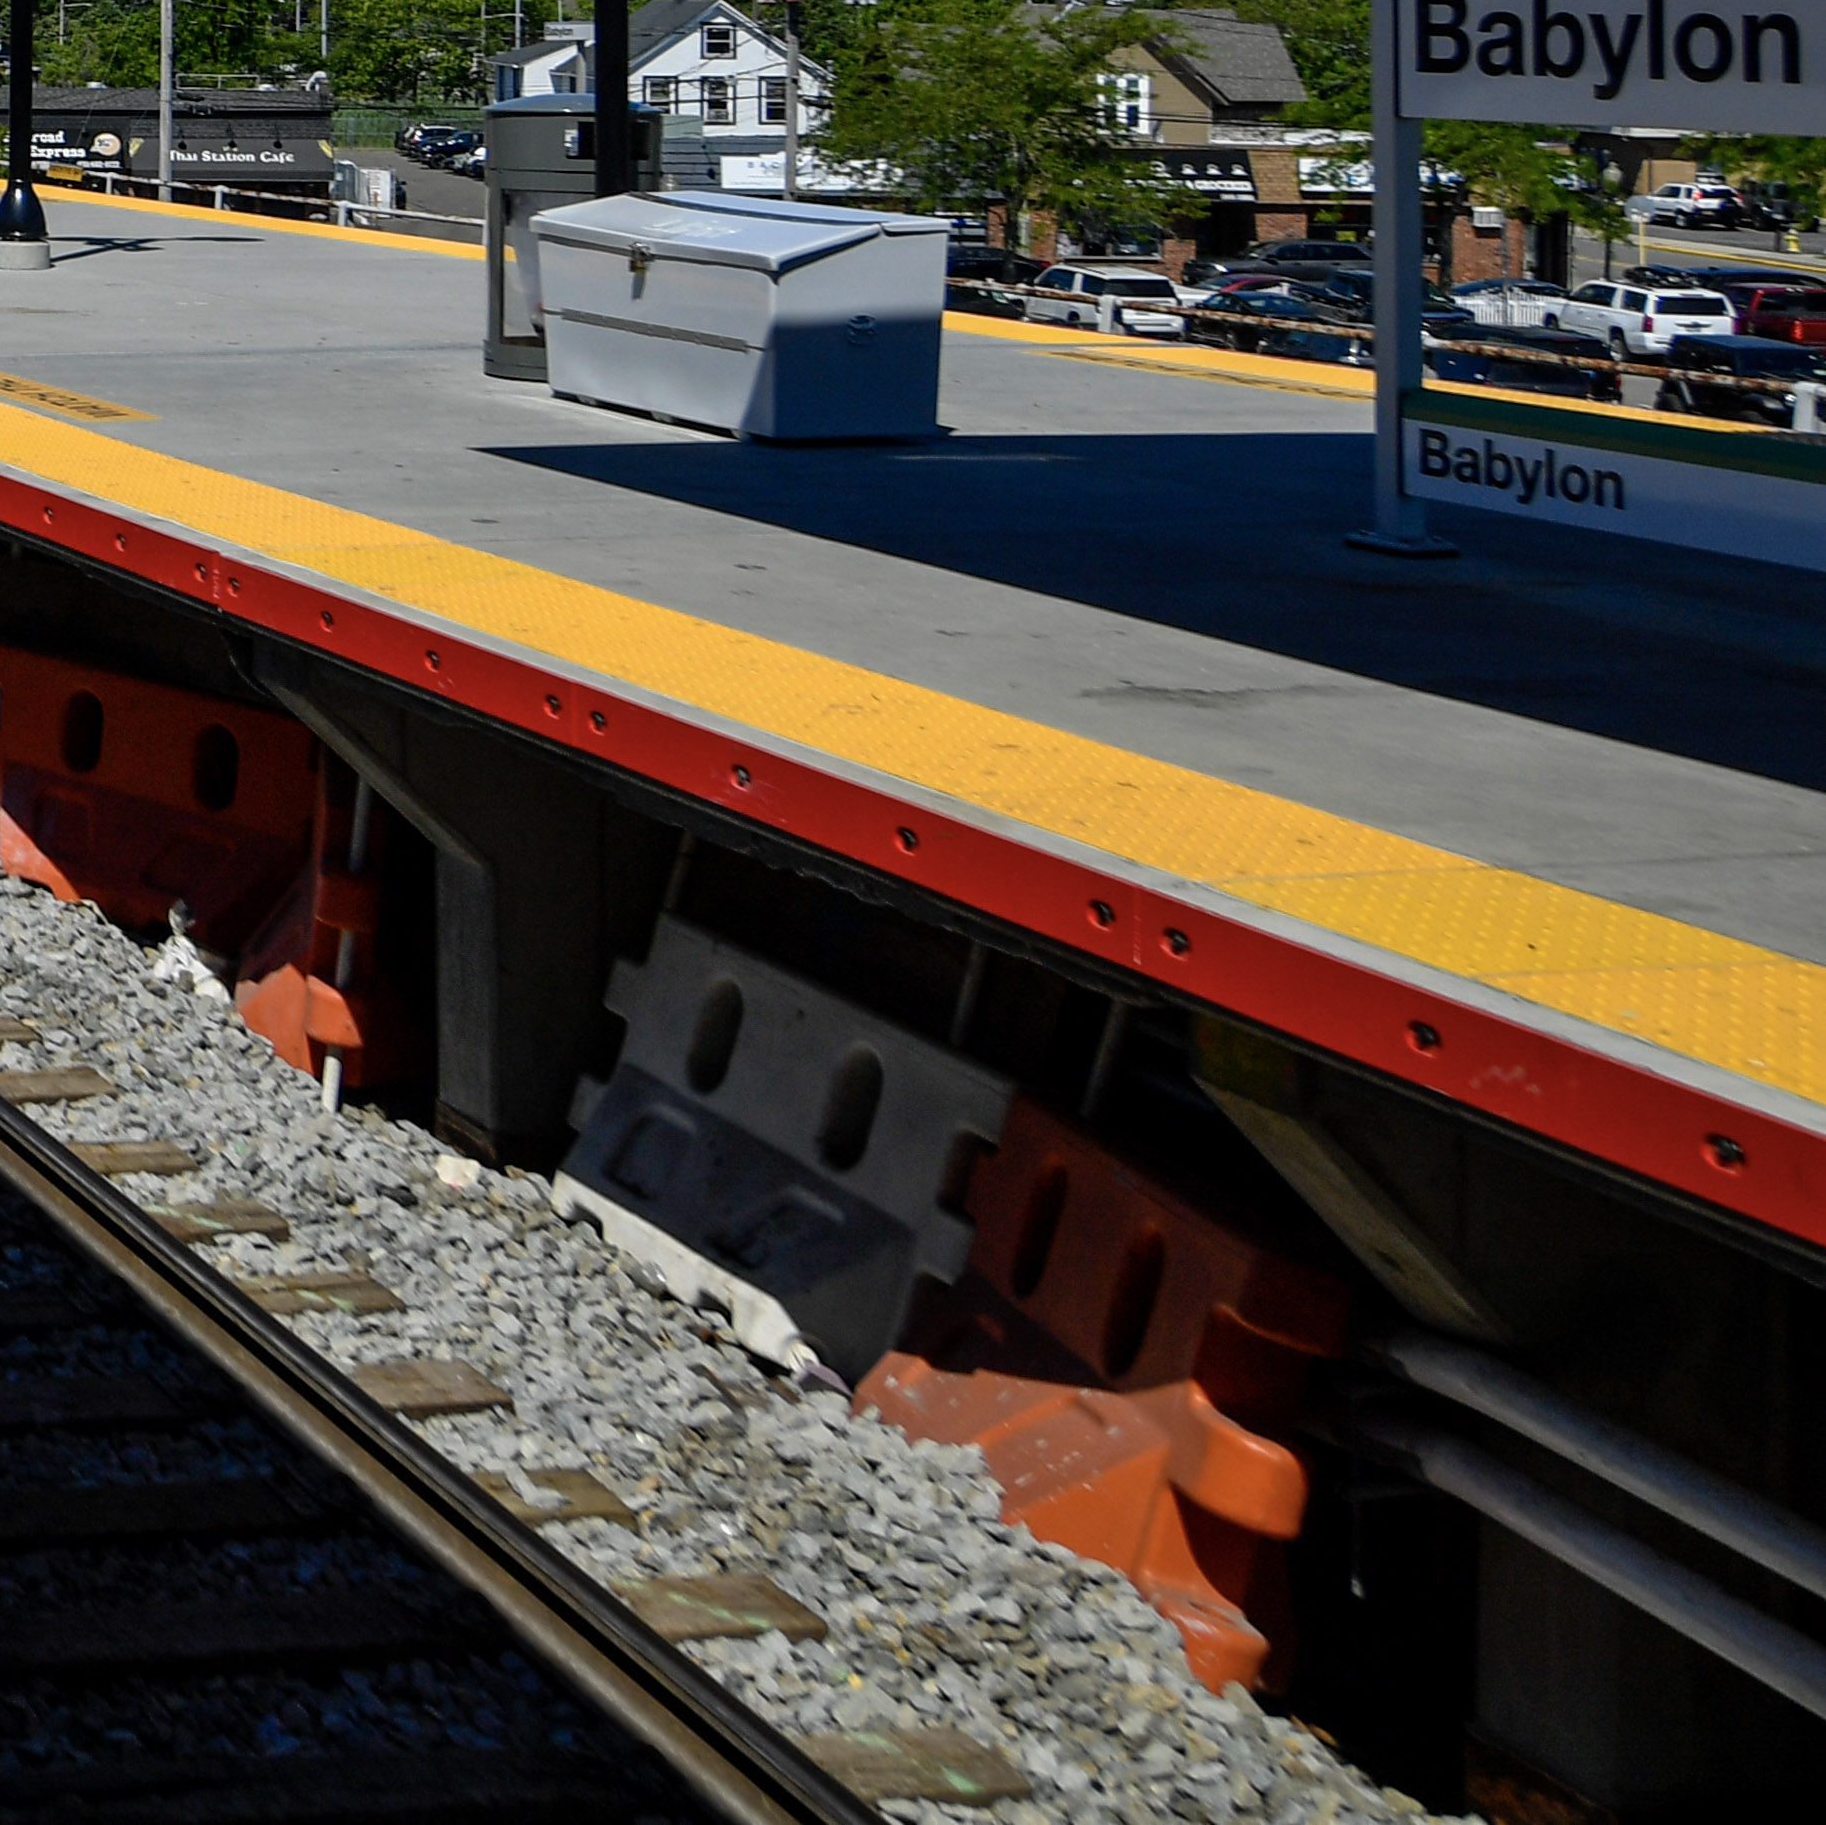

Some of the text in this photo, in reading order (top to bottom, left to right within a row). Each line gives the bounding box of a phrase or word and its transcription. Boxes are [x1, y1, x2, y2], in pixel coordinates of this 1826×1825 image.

[30, 130, 66, 144] road
[201, 150, 256, 163] Station
[259, 151, 295, 164] Cafe
[1419, 428, 1625, 510] Babylon
